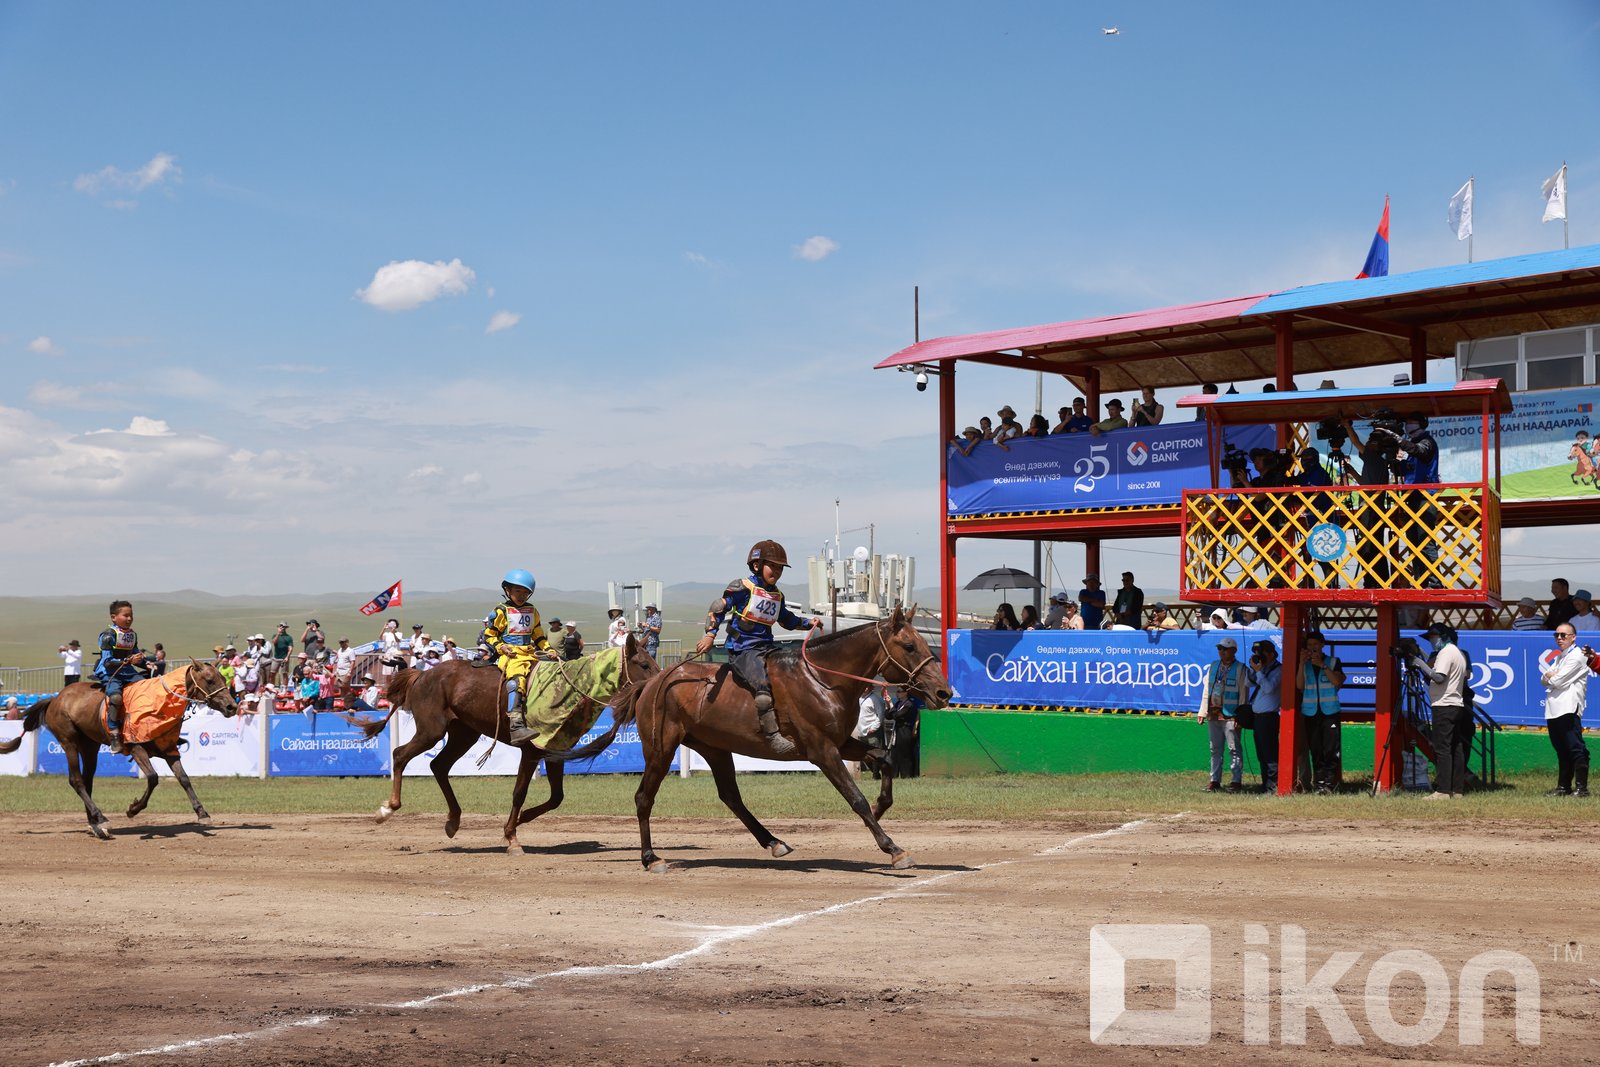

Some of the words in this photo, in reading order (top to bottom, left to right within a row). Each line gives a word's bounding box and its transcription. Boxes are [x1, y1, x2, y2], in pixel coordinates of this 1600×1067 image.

[1523, 416, 1593, 431] НААДААРАЙ.
[1151, 438, 1203, 451] CAPITRON
[1004, 462, 1027, 472] Өнөд
[1027, 461, 1061, 471] дэвжих,
[1074, 443, 1110, 493] 25
[1151, 452, 1180, 463] BANK
[993, 475, 1032, 484] өсөлтийн
[1034, 473, 1061, 483] түүчээ
[1127, 482, 1145, 490] since
[756, 599, 777, 616] 423
[519, 614, 531, 627] 49
[1036, 645, 1067, 655] Өөдлөн
[1069, 646, 1104, 656] дэвжиж,
[1106, 645, 1131, 656] Өргөн
[1133, 648, 1179, 657] түмнээрээ
[986, 652, 1077, 683] Сайхан
[1084, 660, 1212, 696] наадаара
[1467, 647, 1515, 704] 25
[281, 736, 319, 751] Сайхан
[321, 736, 379, 753] наадаарай
